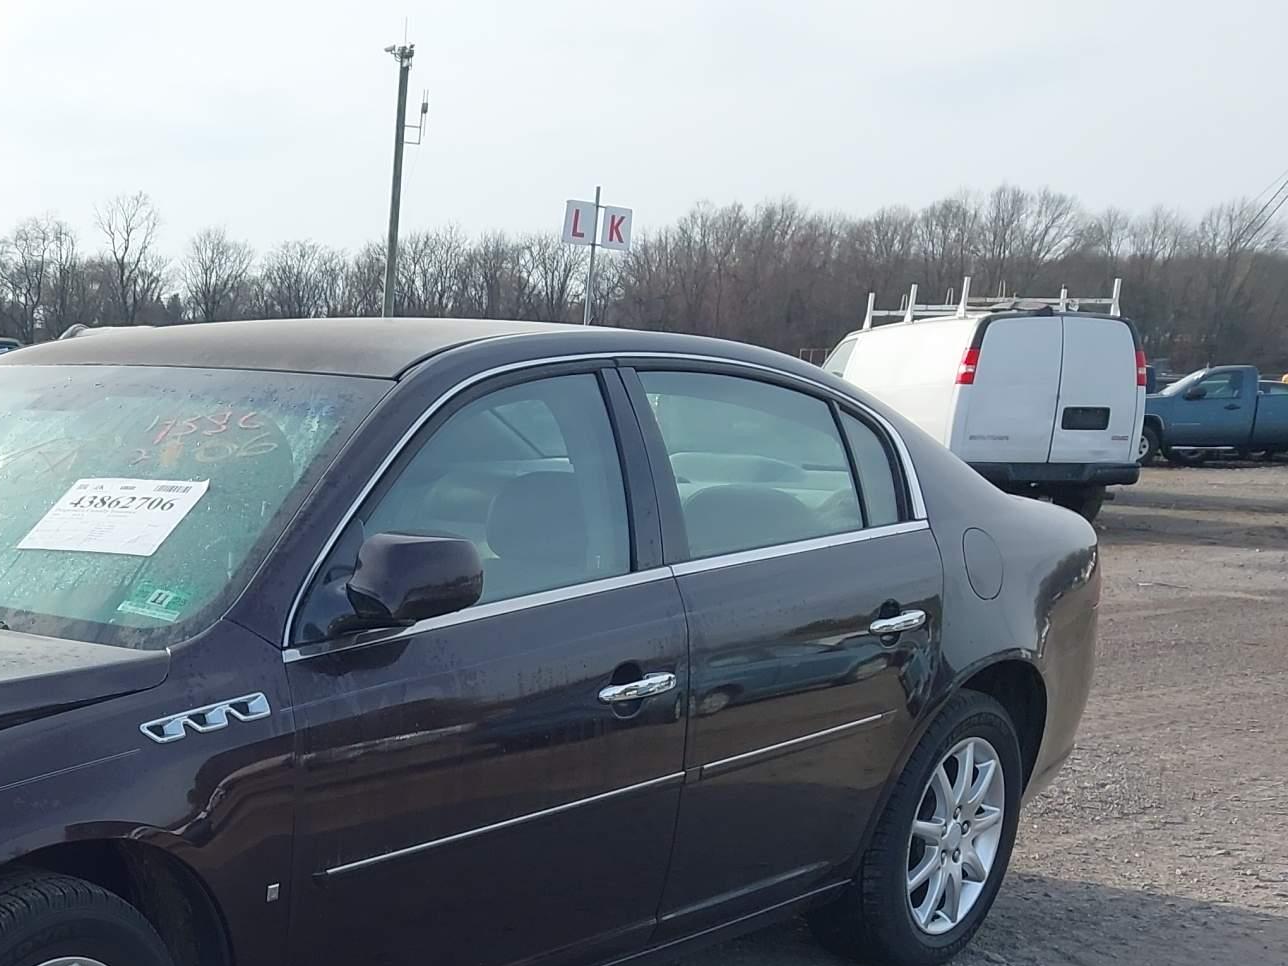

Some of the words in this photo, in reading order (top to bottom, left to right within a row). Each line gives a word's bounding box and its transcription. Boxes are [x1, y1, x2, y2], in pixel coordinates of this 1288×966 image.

[572, 209, 585, 238] L
[608, 214, 626, 243] K
[69, 495, 175, 512] 43862706
